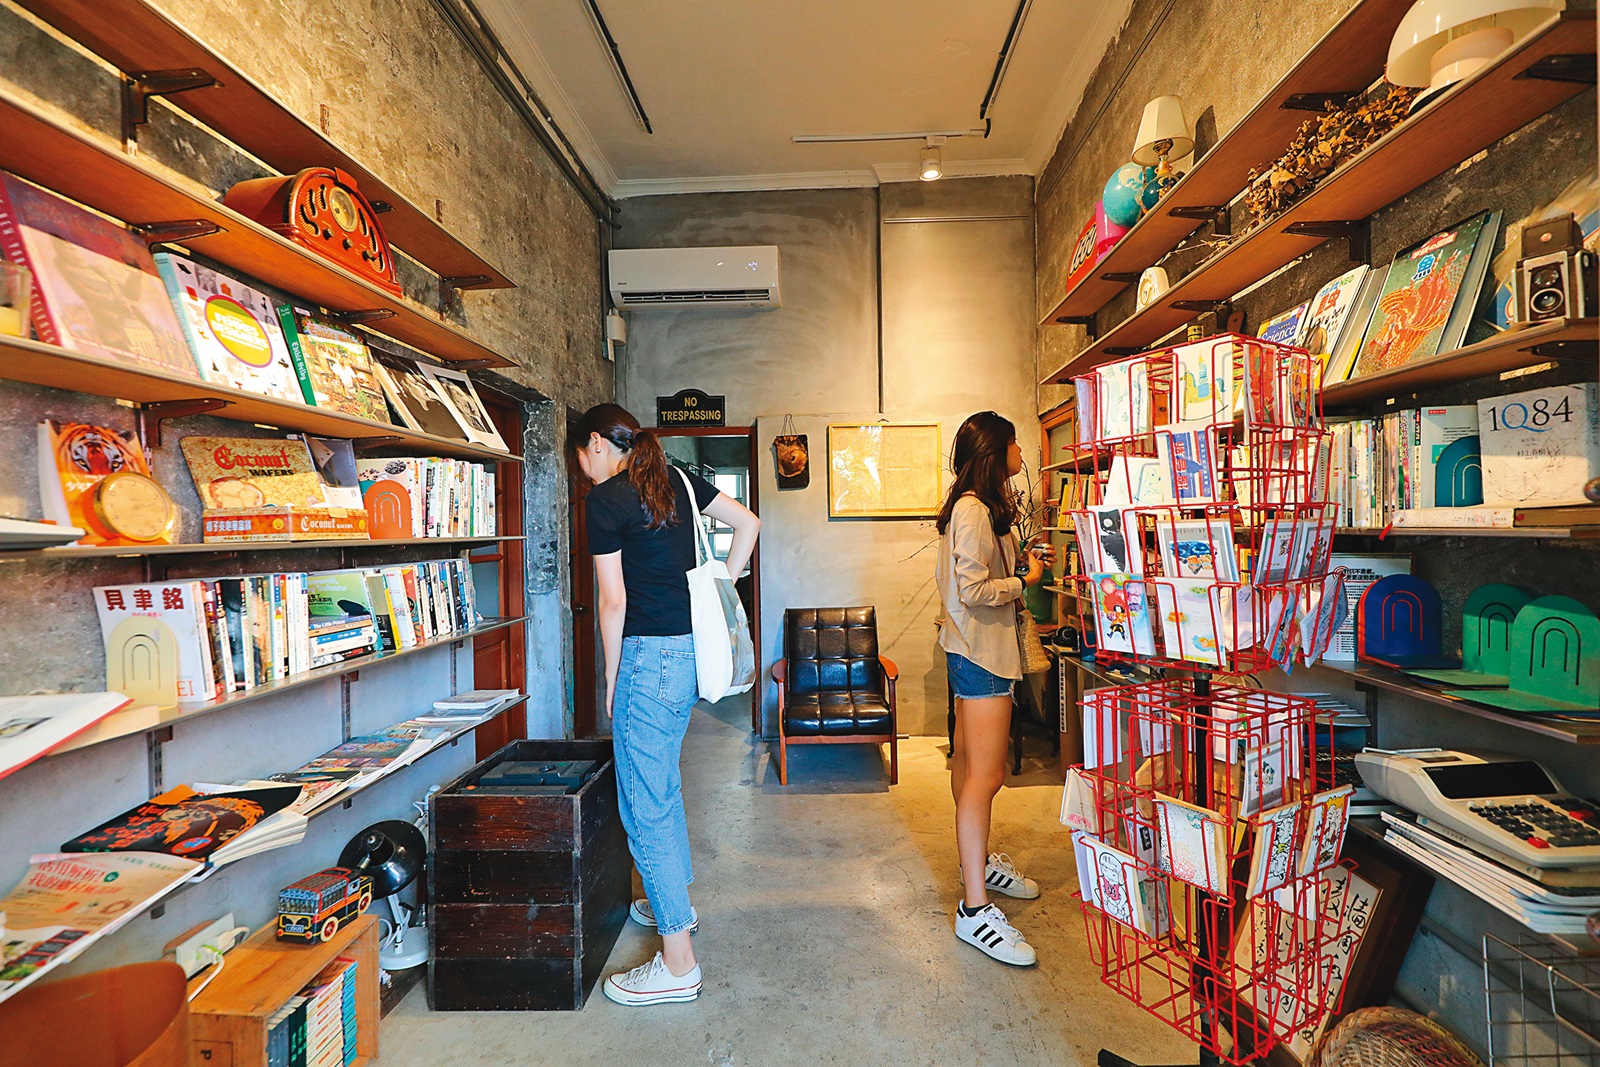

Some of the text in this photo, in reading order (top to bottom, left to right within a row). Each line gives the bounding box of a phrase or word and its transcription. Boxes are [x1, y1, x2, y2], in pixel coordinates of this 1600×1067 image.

[1261, 322, 1296, 342] Science
[684, 397, 698, 407] NO
[661, 409, 722, 421] TRESPASSING
[1487, 395, 1574, 433] 1Q84
[213, 445, 292, 470] Coconut
[248, 469, 294, 477] WAFERS
[301, 516, 336, 531] Coconut
[104, 587, 185, 611] 貝聿銘
[177, 680, 195, 697] EI
